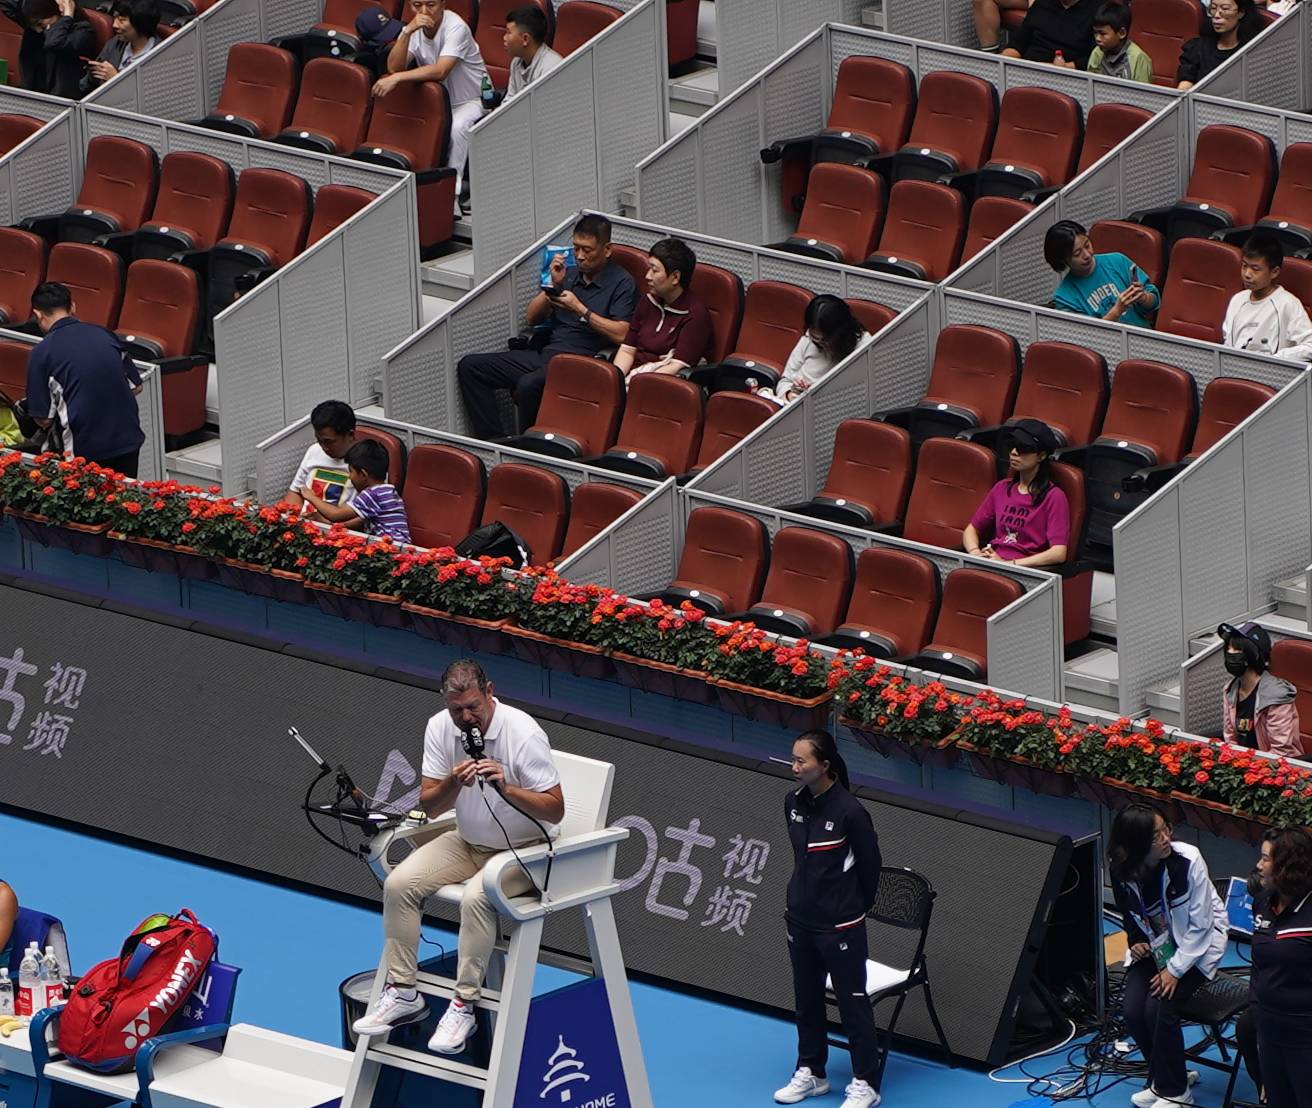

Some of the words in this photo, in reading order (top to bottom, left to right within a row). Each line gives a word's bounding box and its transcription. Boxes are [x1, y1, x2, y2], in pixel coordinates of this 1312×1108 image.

[22, 661, 87, 759] 视频
[610, 814, 716, 922] 咕
[700, 833, 770, 936] 视频
[149, 949, 202, 1014] YONEX
